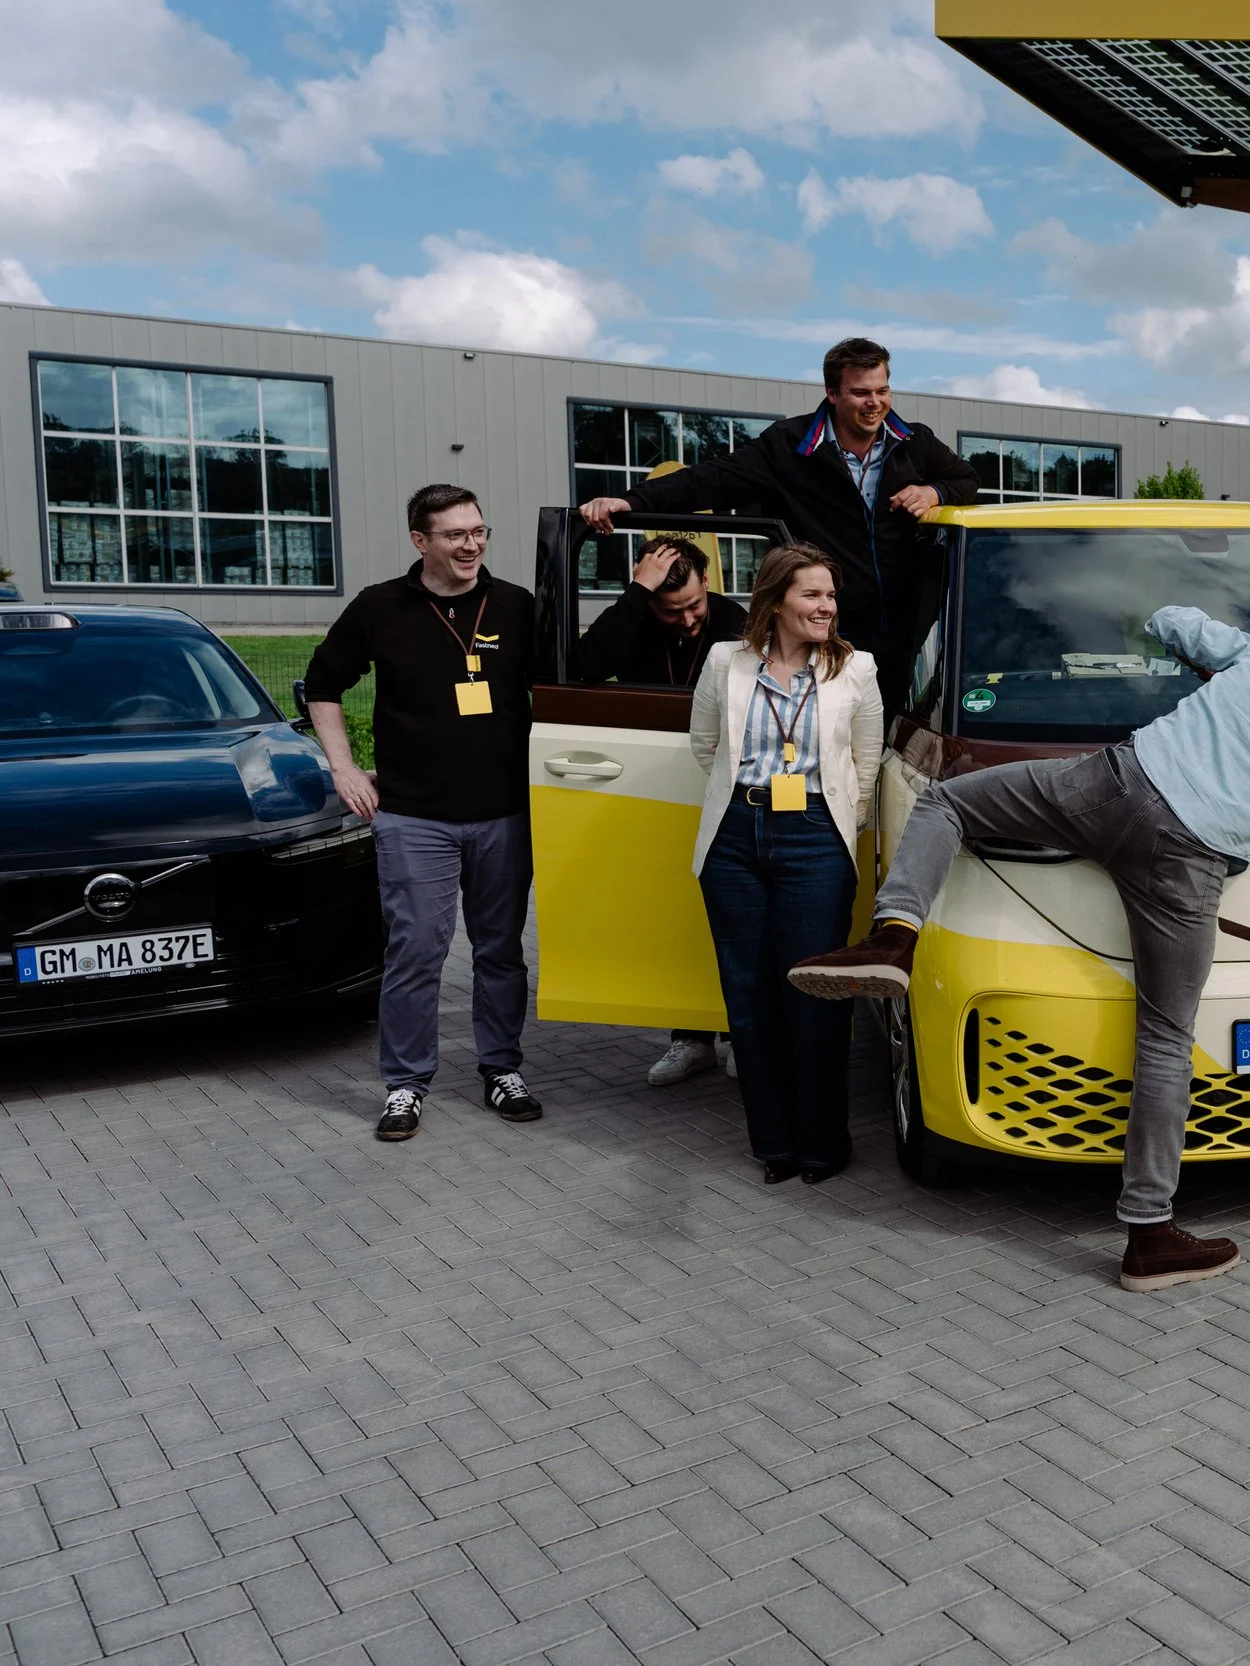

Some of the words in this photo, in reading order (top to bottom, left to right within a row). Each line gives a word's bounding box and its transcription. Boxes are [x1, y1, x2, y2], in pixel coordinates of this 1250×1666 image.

[475, 642, 499, 650] Fastned
[975, 690, 984, 700] 4
[24, 967, 32, 976] D
[40, 947, 78, 975] GM
[97, 942, 133, 969] MA
[141, 934, 209, 964] 837E
[131, 967, 162, 975] AMELUNG
[1242, 1049, 1250, 1059] D
